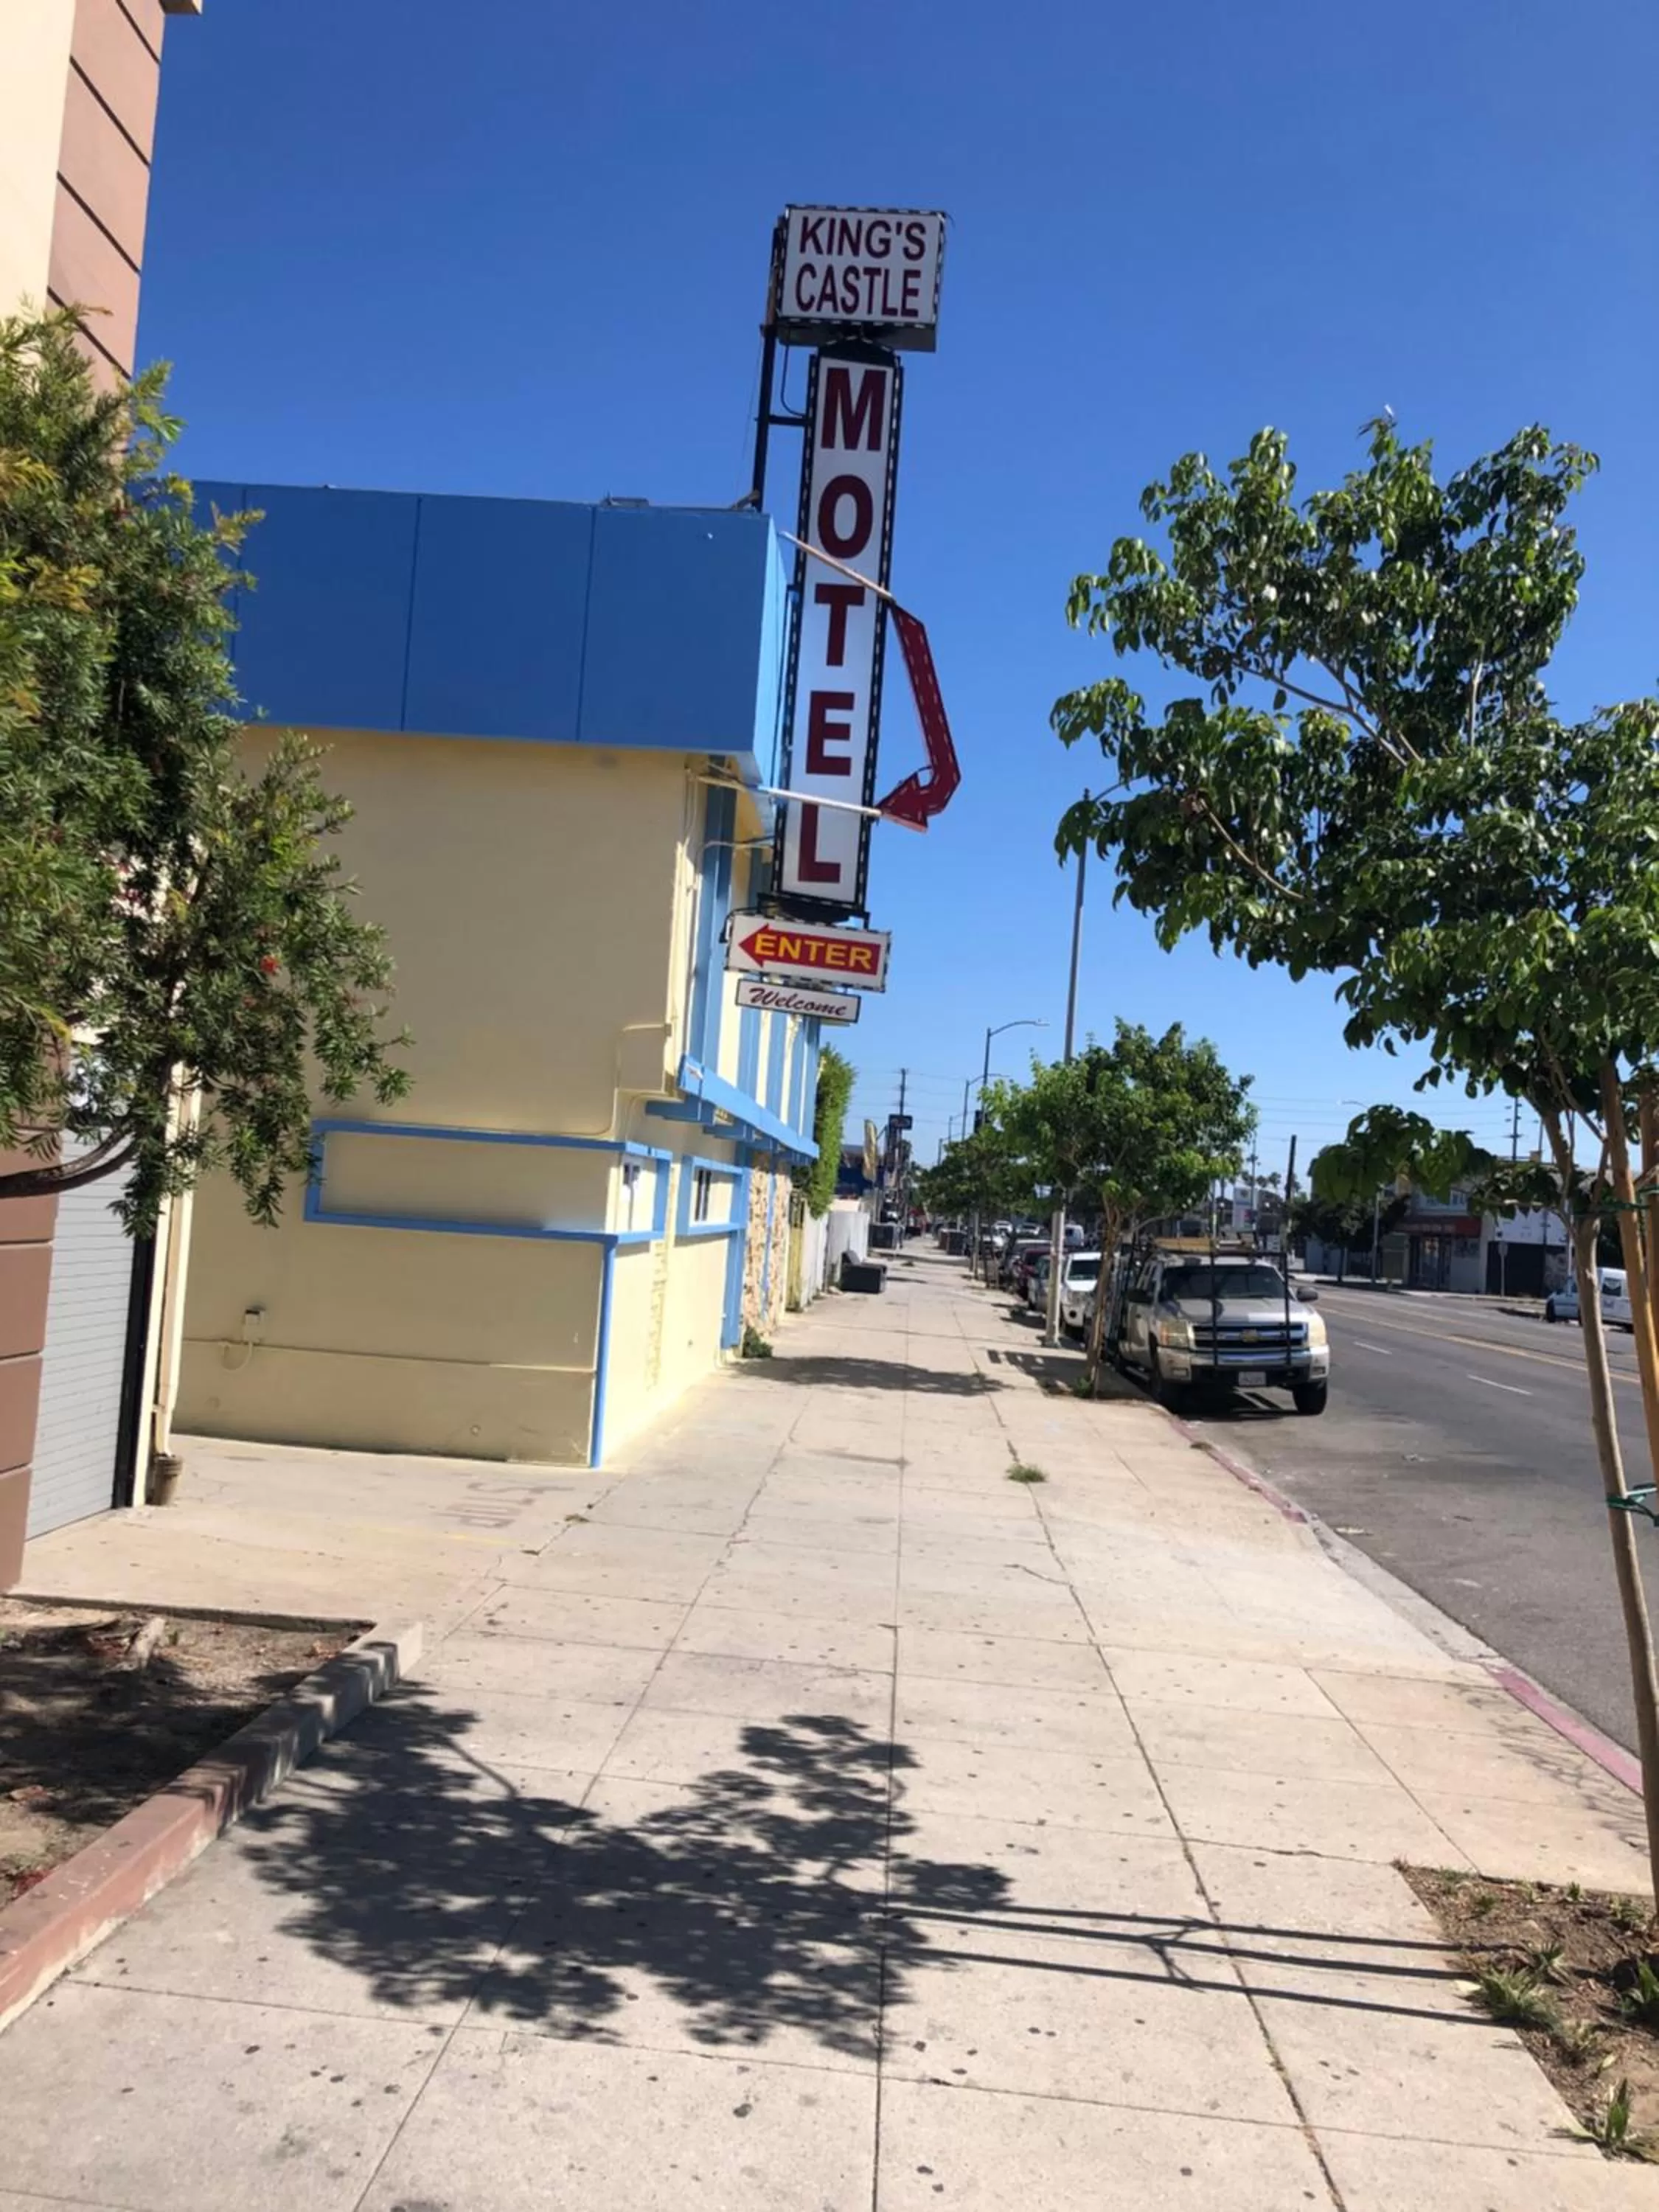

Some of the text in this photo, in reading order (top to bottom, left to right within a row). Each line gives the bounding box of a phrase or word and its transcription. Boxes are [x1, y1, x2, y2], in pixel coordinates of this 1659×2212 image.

[799, 215, 927, 261] KING'S
[795, 262, 922, 318] CASTLE
[798, 366, 887, 883] MOTEL
[754, 933, 873, 970] ENTER
[748, 987, 848, 1016] Welcome
